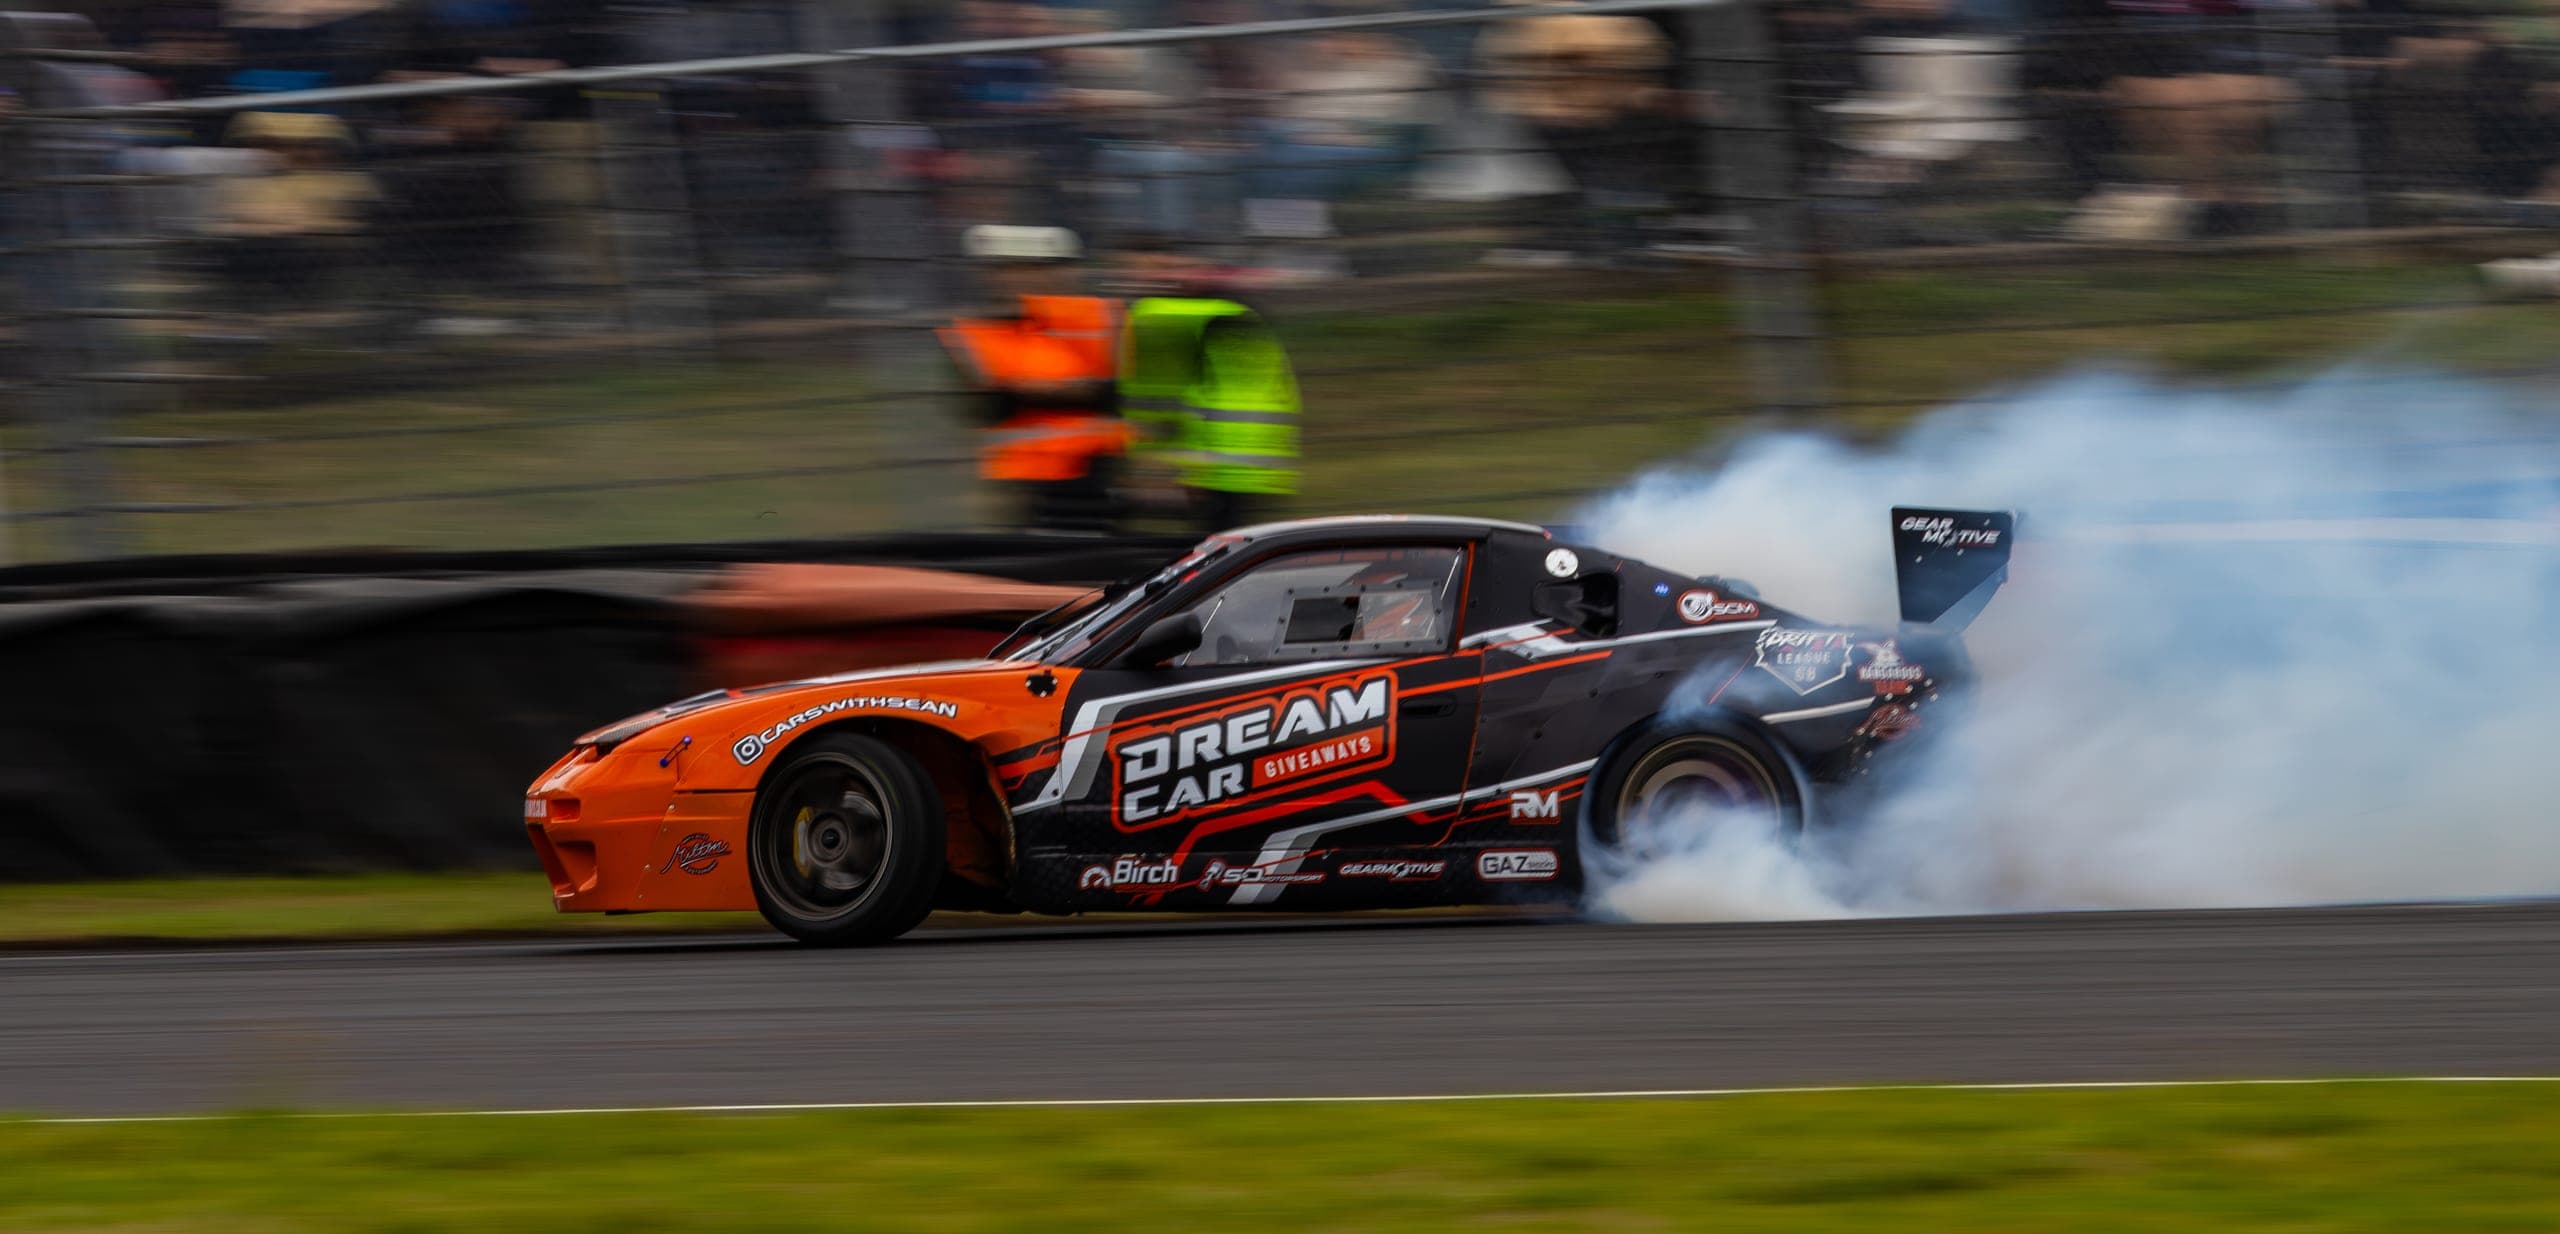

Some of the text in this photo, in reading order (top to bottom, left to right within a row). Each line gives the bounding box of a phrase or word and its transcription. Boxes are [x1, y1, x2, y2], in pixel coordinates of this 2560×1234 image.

[1900, 516, 1954, 531] GEAR
[1777, 652, 1831, 665] LEAGUE
[760, 696, 958, 745] CARSWITHSEAN
[1120, 679, 1387, 785] DREAM
[1264, 736, 1372, 779] GIVEAWAYS
[1123, 762, 1245, 822] CAR
[1511, 791, 1558, 818] RM
[1113, 858, 1178, 884] Birch
[1482, 856, 1529, 874] GAZ
